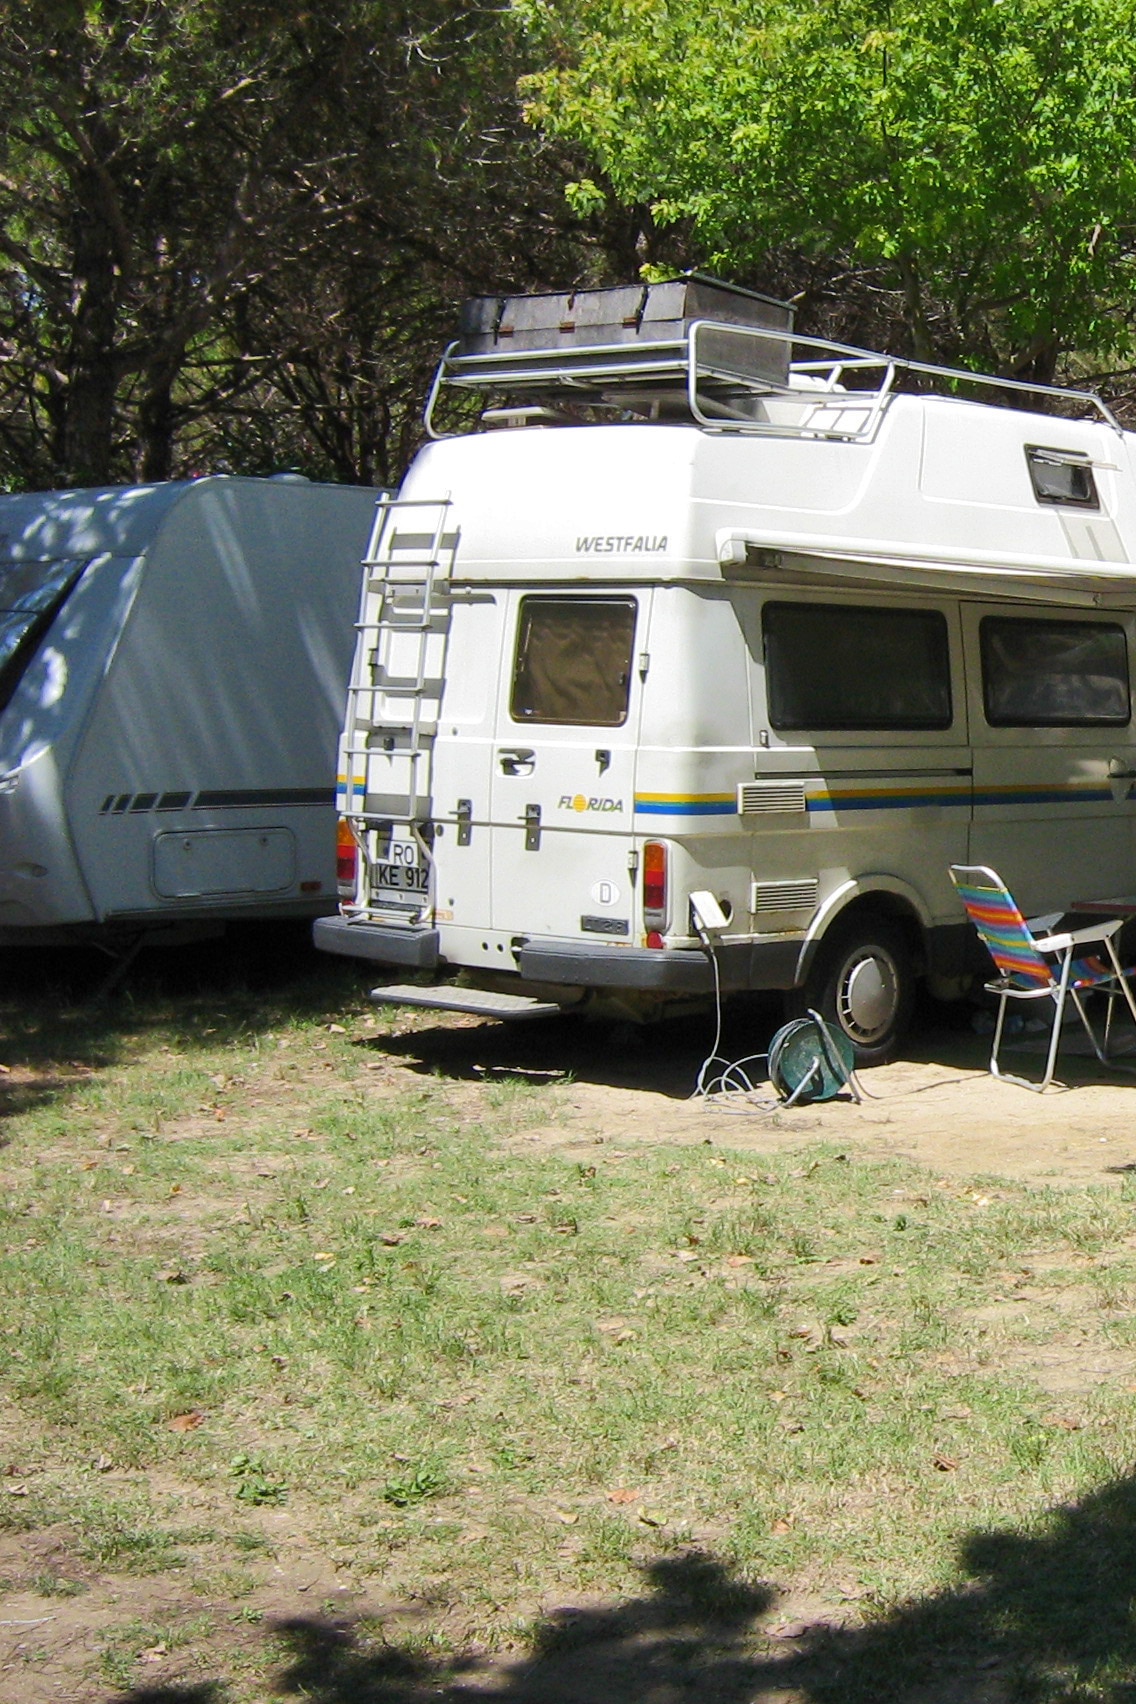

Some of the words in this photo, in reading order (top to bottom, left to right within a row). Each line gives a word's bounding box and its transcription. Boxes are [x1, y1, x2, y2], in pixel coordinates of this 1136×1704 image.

[576, 535, 668, 553] WESTFALIA
[558, 794, 624, 813] FLORIDA
[393, 844, 415, 865] RO
[379, 865, 400, 886] KE
[405, 867, 429, 889] 912
[599, 882, 612, 904] D
